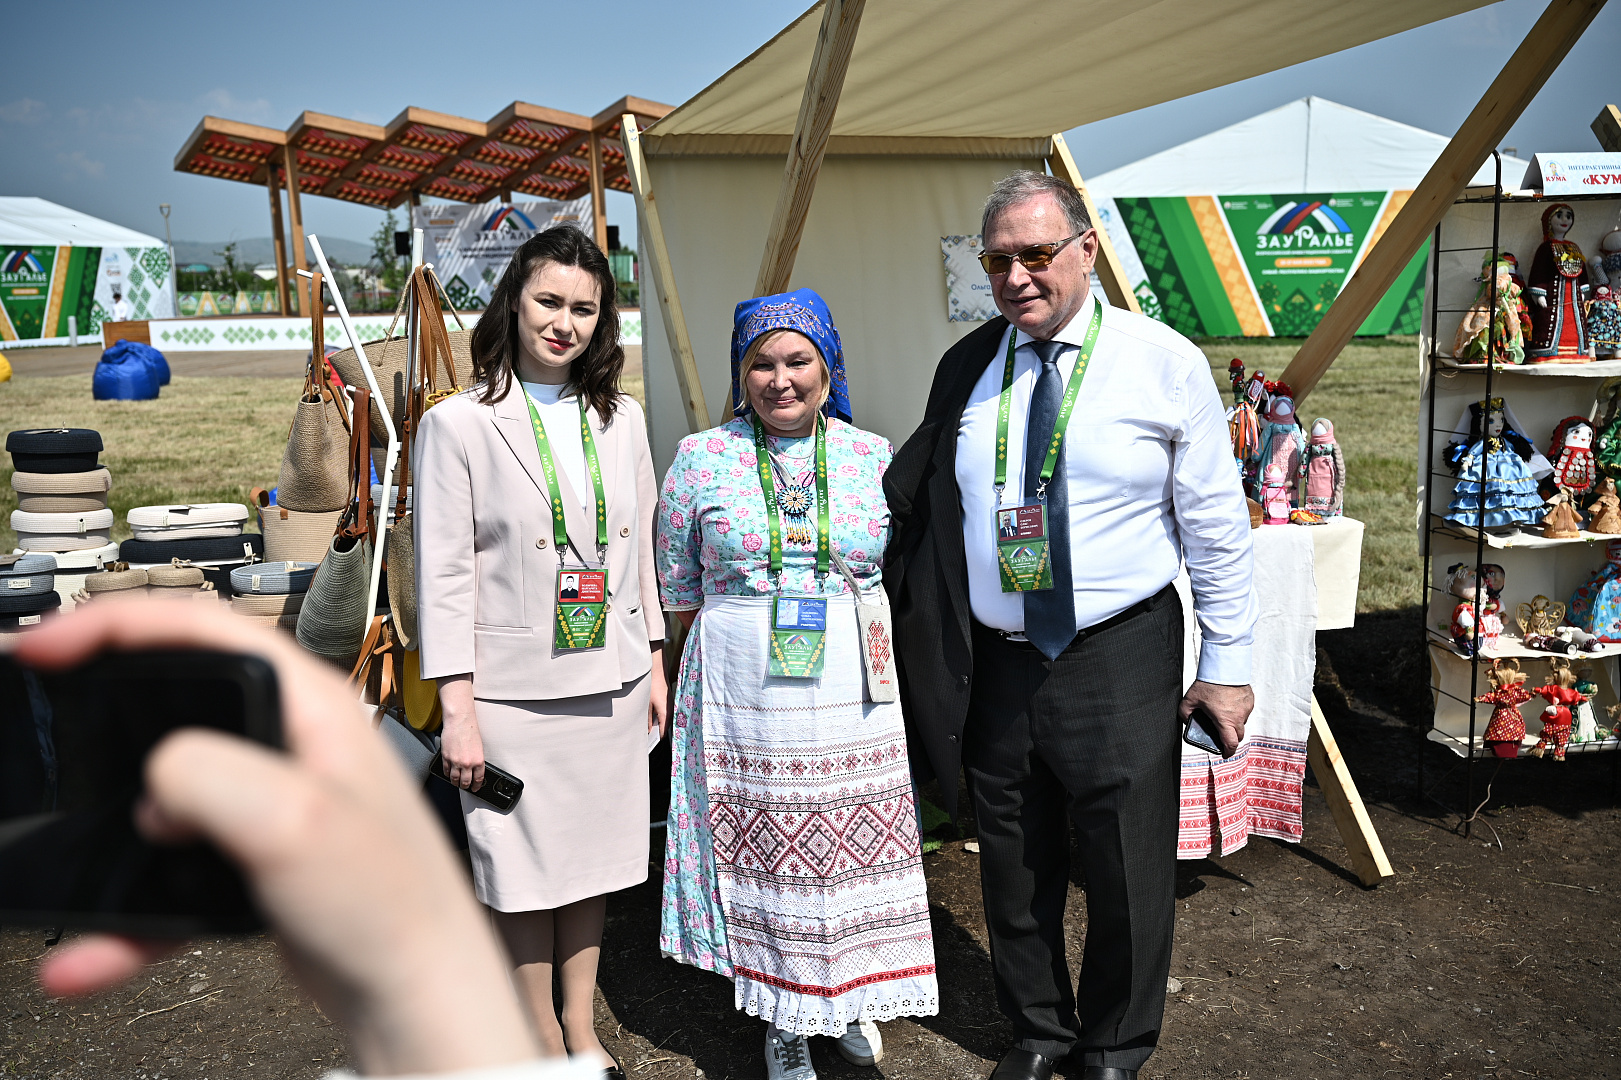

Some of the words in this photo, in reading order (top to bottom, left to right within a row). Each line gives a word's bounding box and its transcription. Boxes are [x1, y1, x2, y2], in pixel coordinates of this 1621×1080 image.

[1256, 225, 1354, 249] ЗАУРАЛЬЕ
[1, 266, 47, 283] ЗАУРАЛЬЕ
[784, 643, 813, 651] ЗАУРАЛЬЕ
